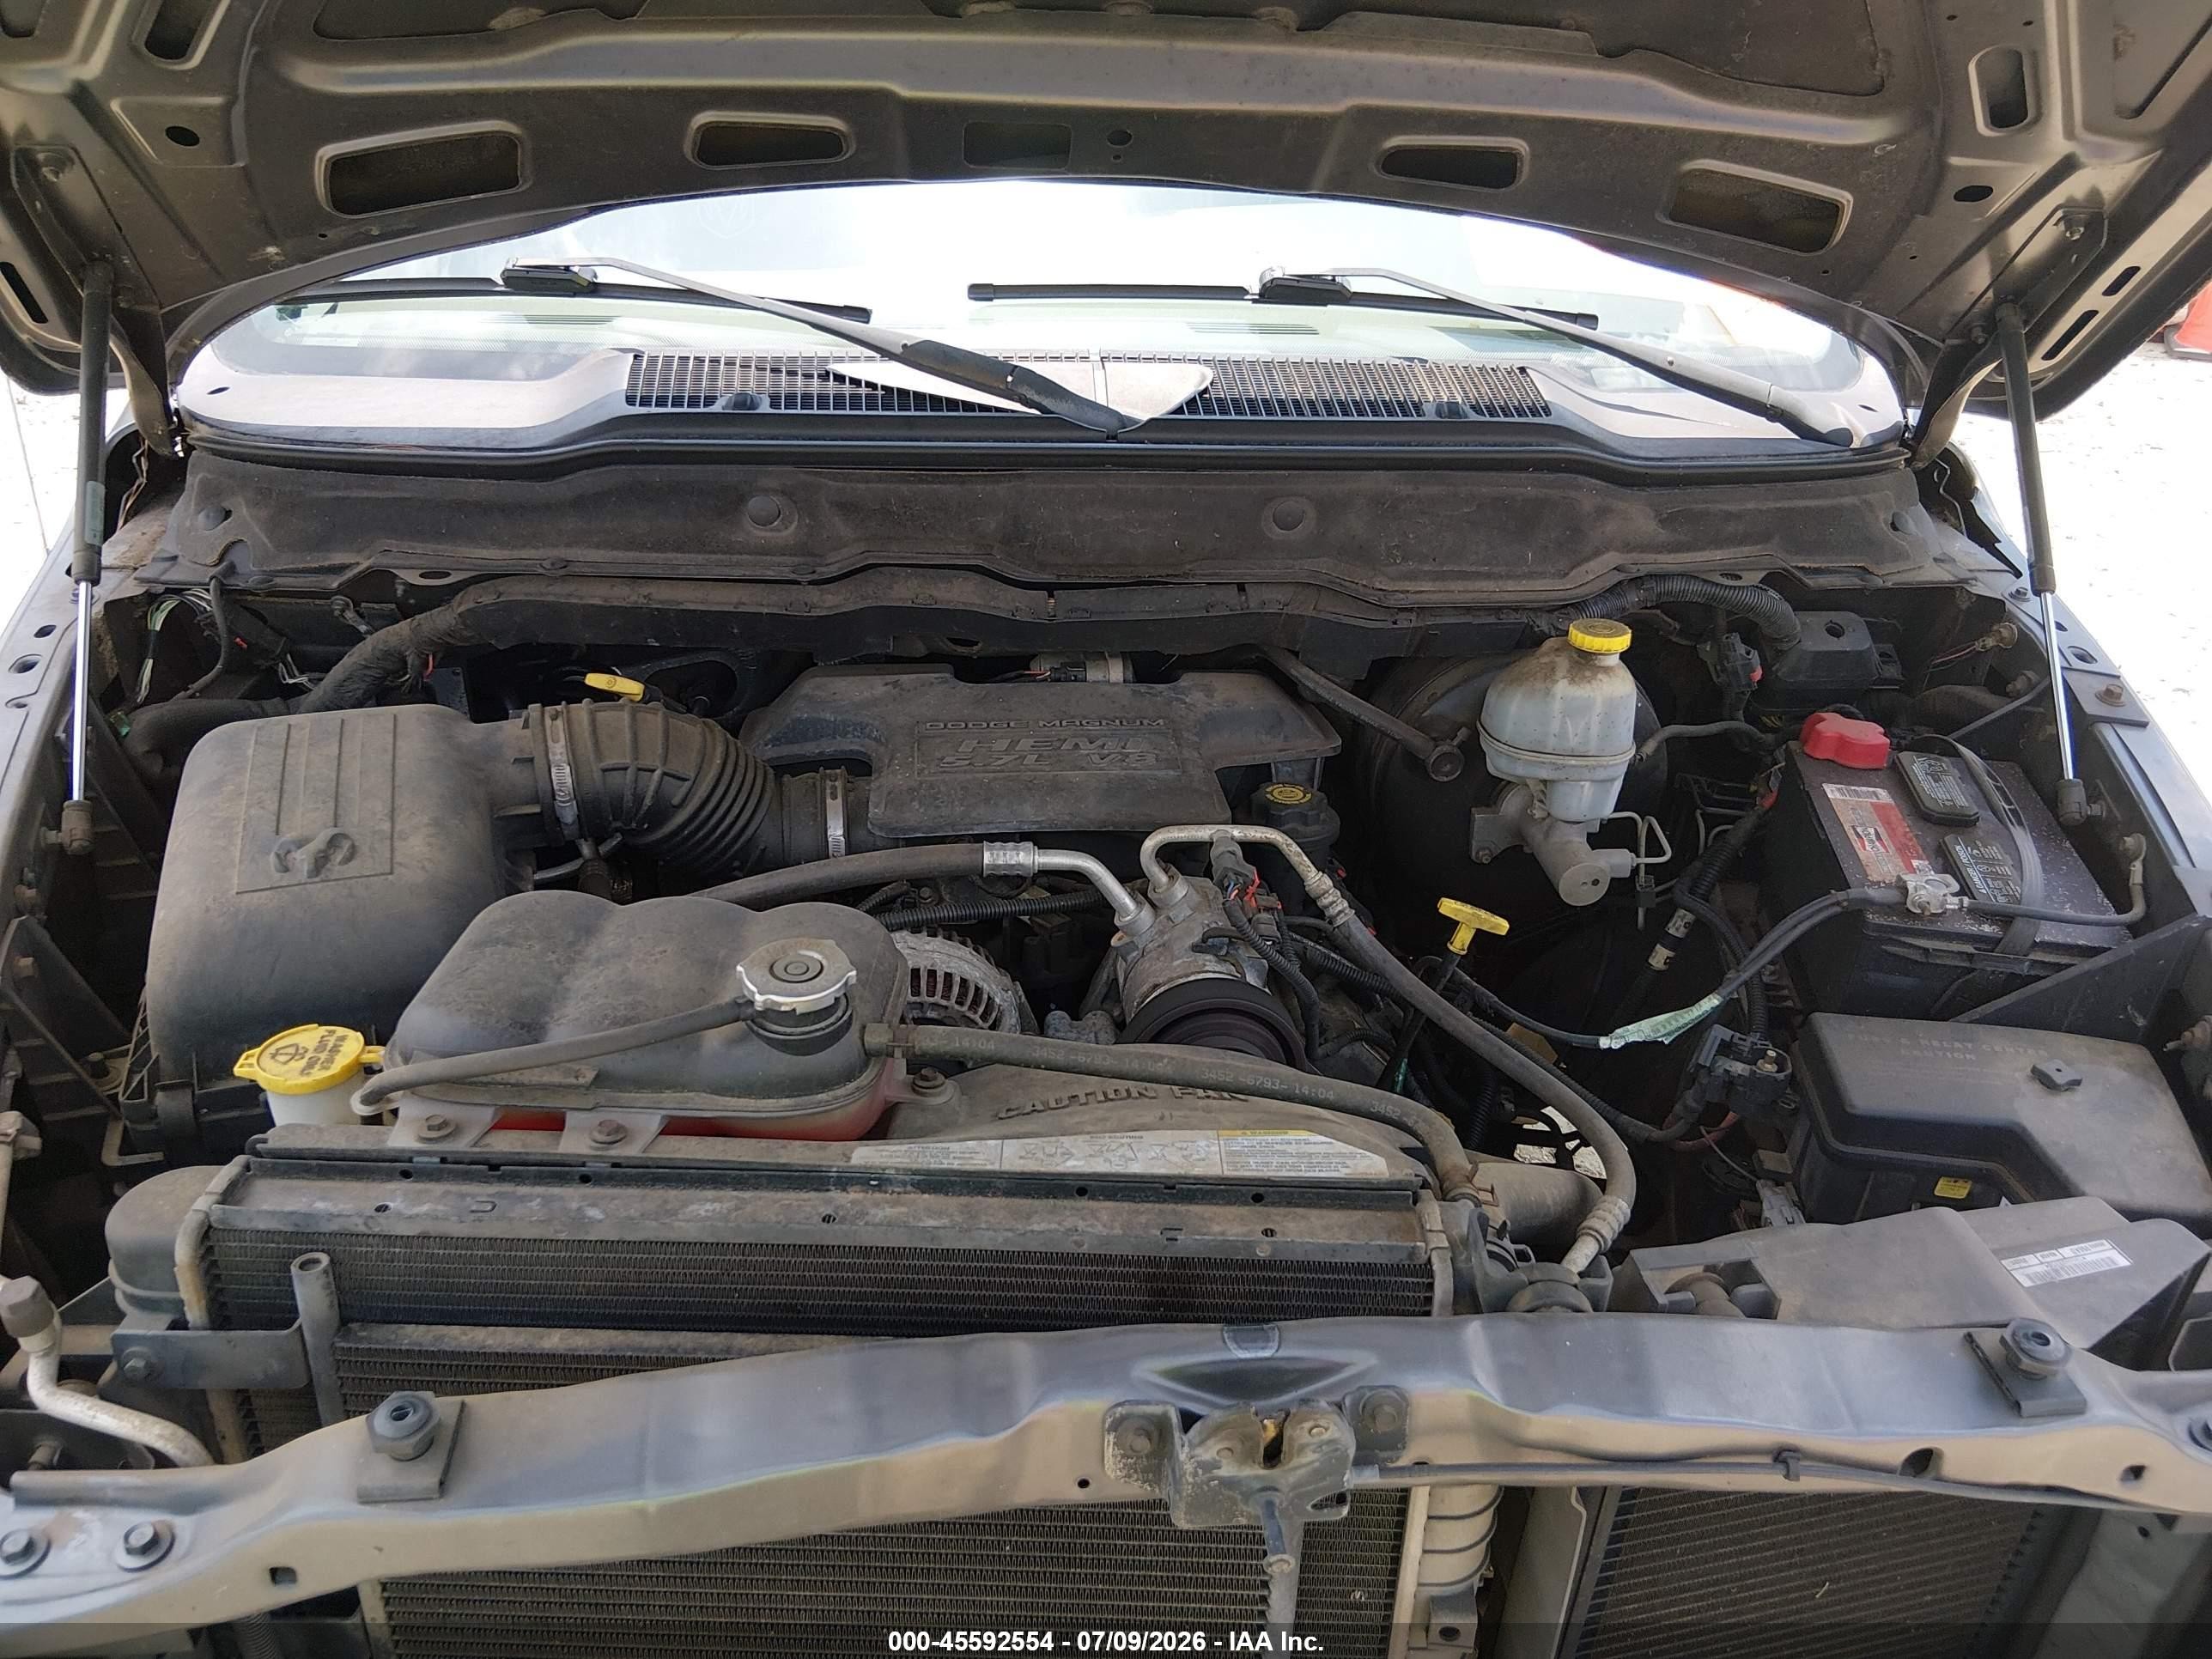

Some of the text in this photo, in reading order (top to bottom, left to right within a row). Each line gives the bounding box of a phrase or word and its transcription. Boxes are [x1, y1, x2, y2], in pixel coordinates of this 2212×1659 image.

[926, 718, 1165, 730] DODGE MAGNUM
[957, 737, 1150, 753] HEMI
[939, 752, 1158, 768] 5.7L V8
[1201, 1070, 1234, 1083] 3452
[1294, 1083, 1335, 1099] 14:04
[997, 1085, 1158, 1121] CAUTION
